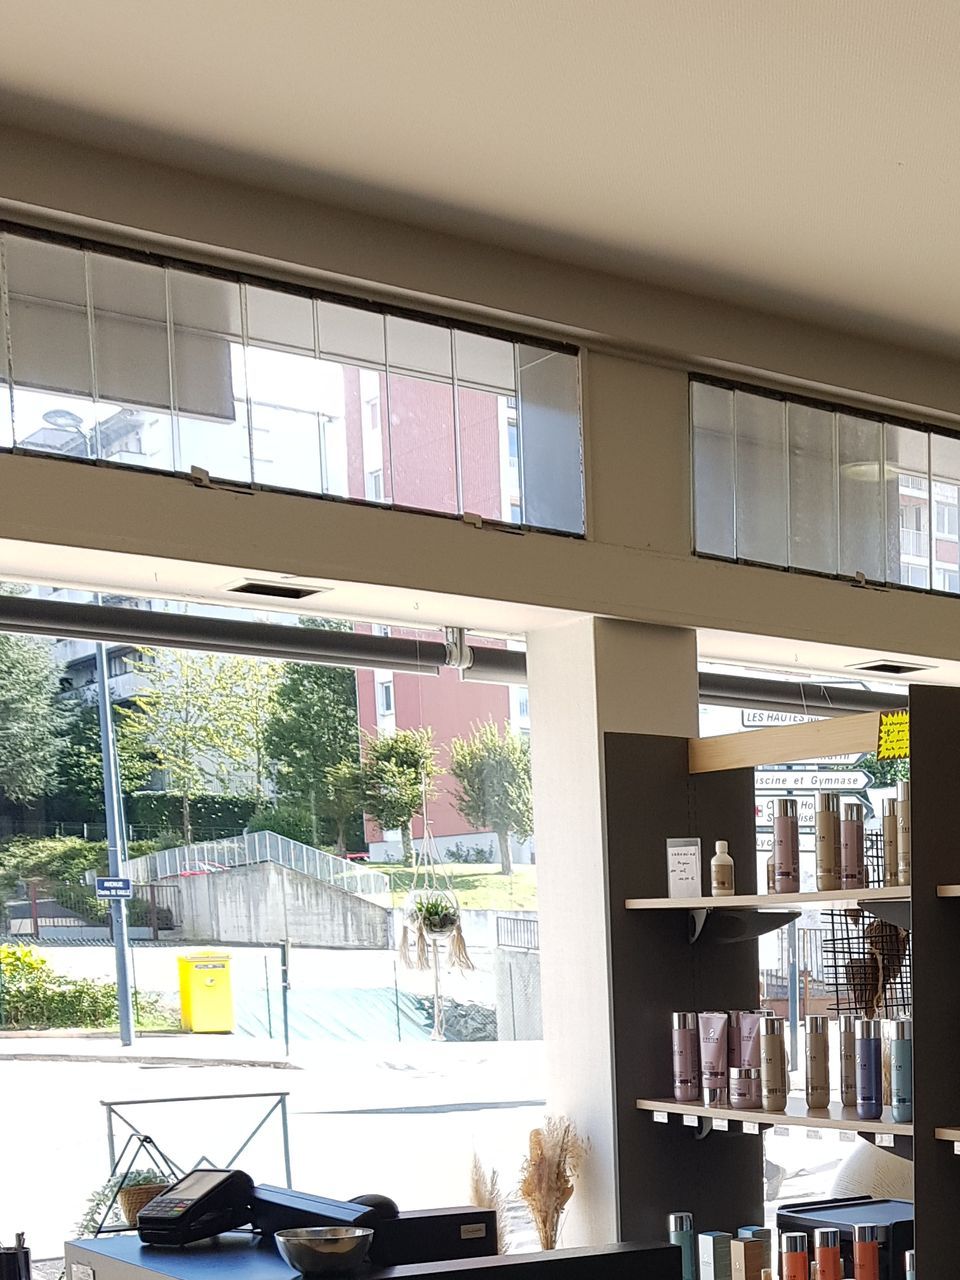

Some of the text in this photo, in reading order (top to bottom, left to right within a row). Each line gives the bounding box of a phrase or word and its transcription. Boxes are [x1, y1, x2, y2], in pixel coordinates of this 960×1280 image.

[747, 713, 764, 722] LES
[755, 776, 859, 788] iscine et Gymnase
